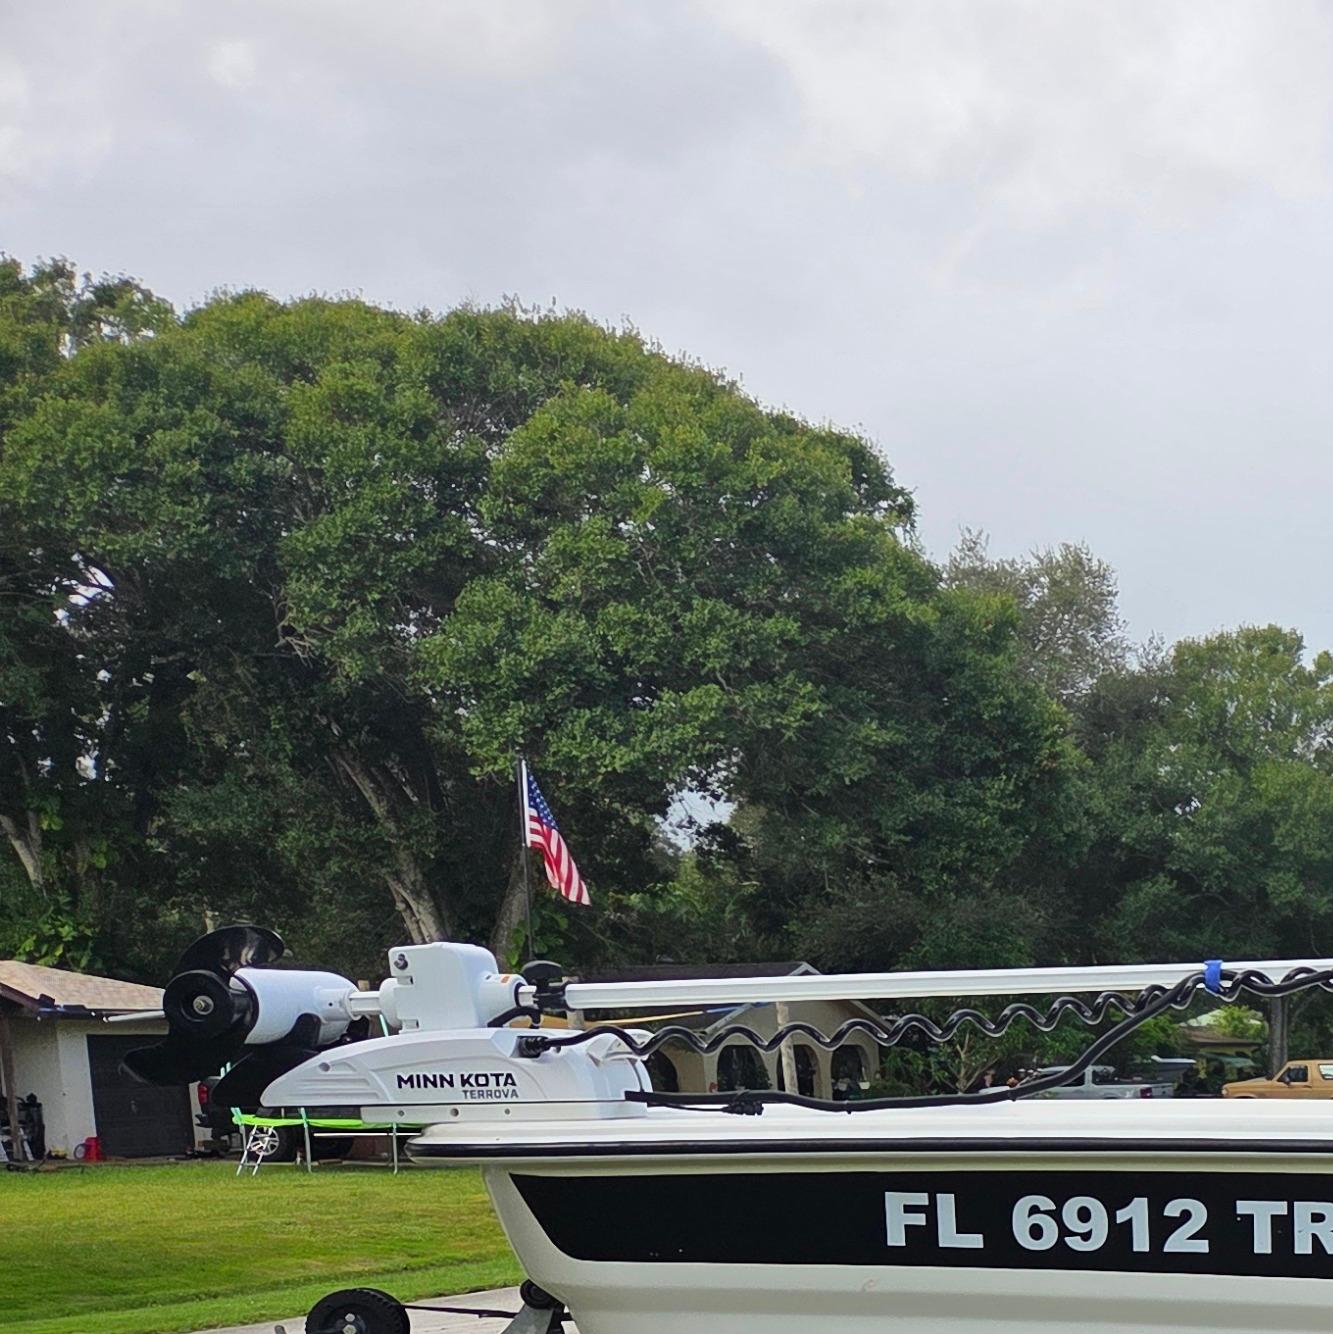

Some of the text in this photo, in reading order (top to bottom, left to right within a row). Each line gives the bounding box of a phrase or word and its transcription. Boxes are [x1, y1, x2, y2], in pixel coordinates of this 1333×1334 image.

[396, 1072, 517, 1089] MINN KOTA
[462, 1088, 519, 1100] TERROVA
[884, 1191, 985, 1249] FL
[1011, 1194, 1210, 1253] 6912
